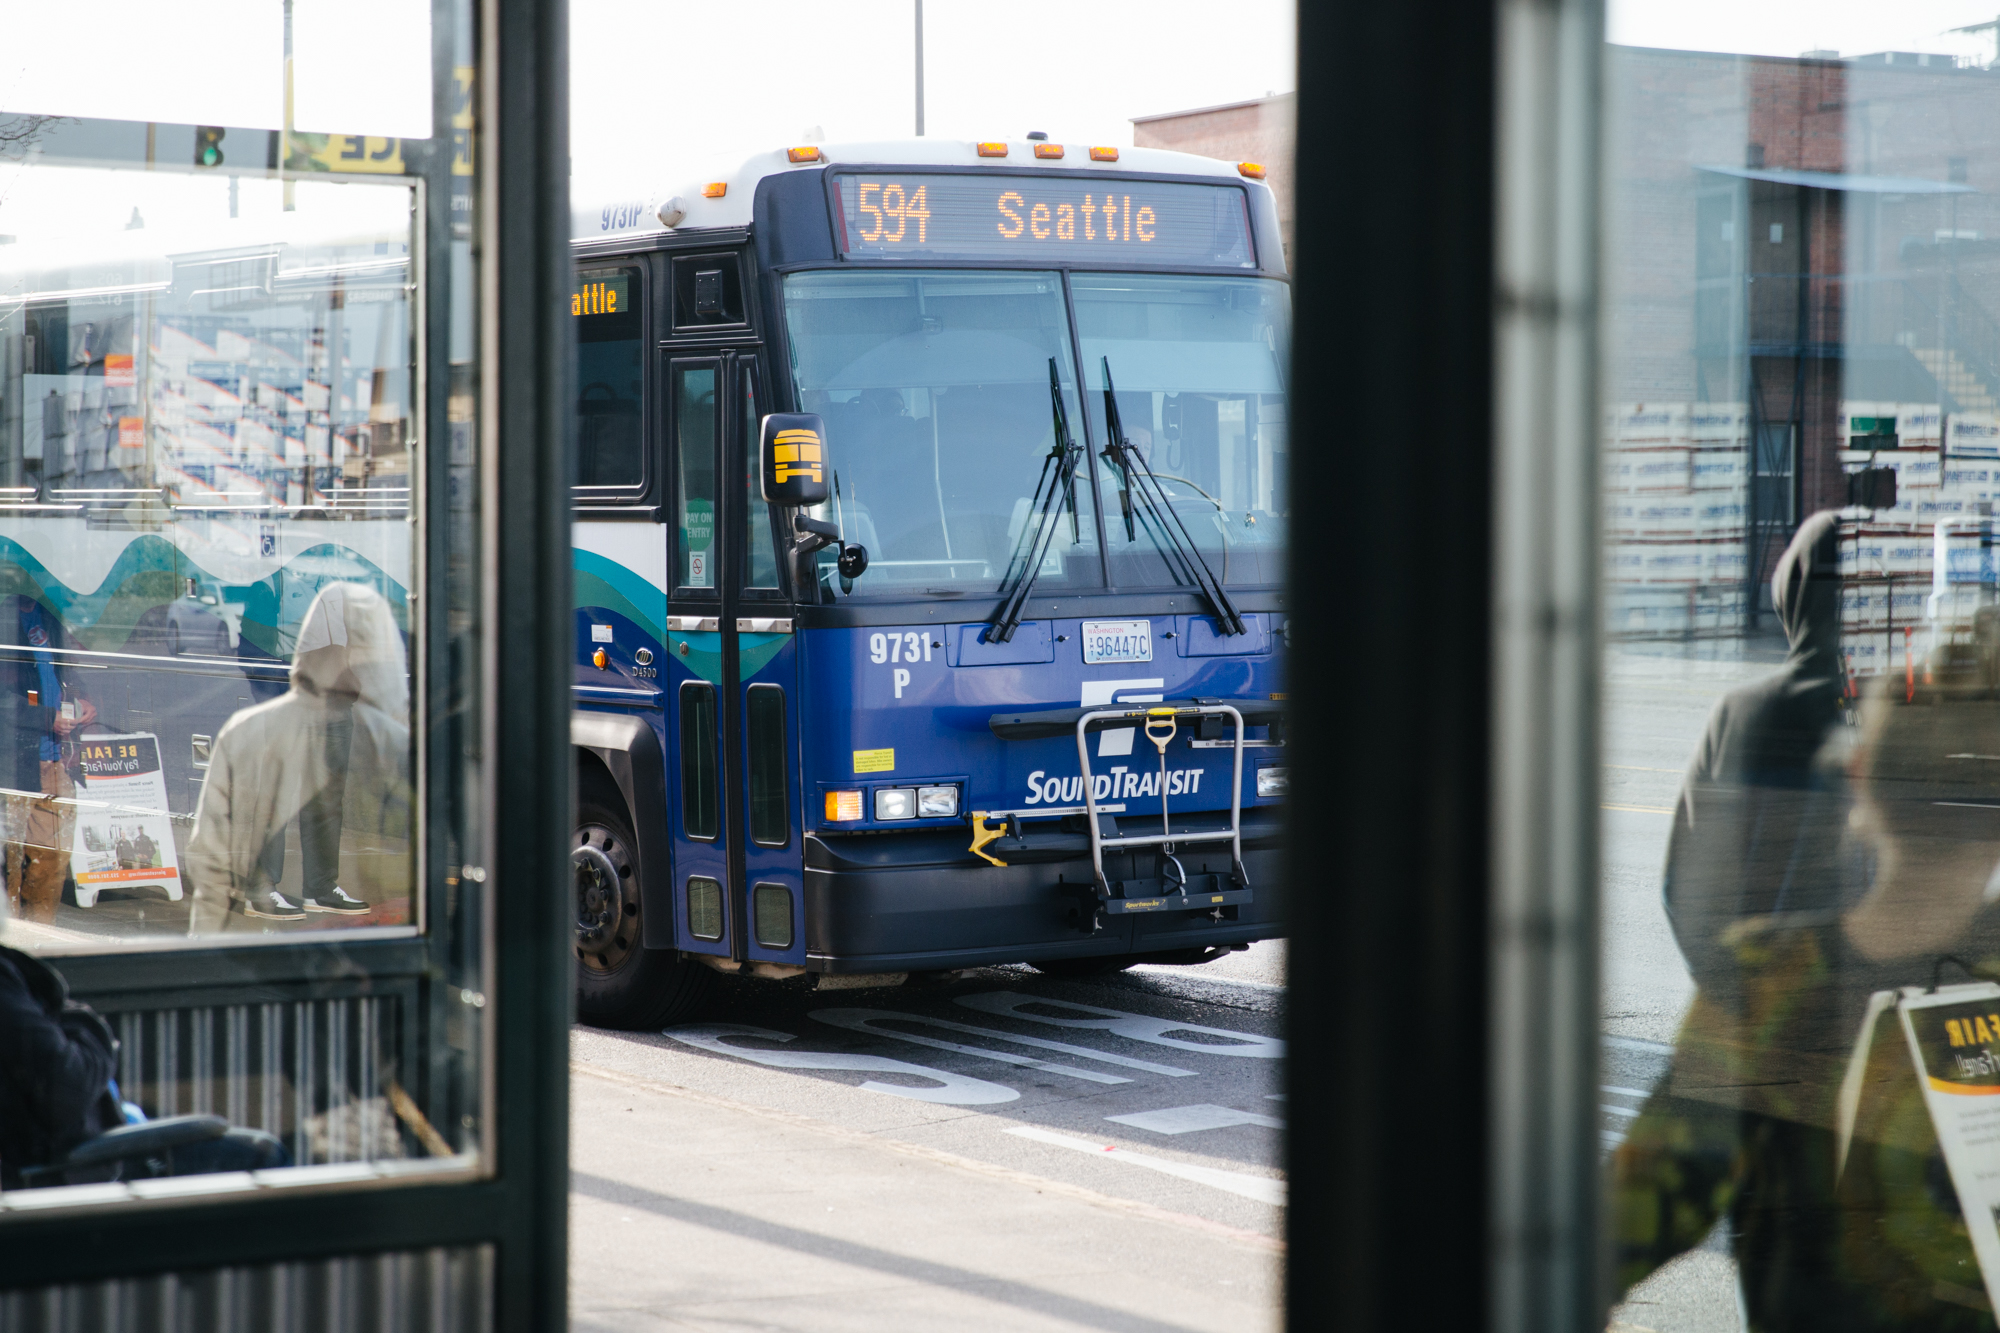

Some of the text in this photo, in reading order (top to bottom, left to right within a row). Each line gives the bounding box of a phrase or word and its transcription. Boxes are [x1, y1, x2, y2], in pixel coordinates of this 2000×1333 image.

[601, 202, 643, 231] 9731P
[859, 183, 1156, 242] 594 Seattle
[571, 283, 616, 316] attle
[686, 512, 712, 523] PAY ON
[687, 527, 710, 538] ENTRY
[870, 632, 932, 664] 9731
[1096, 635, 1148, 656] 96447C
[632, 666, 656, 678] D4500
[894, 668, 910, 699] P
[1124, 899, 1160, 909] Sportworks
